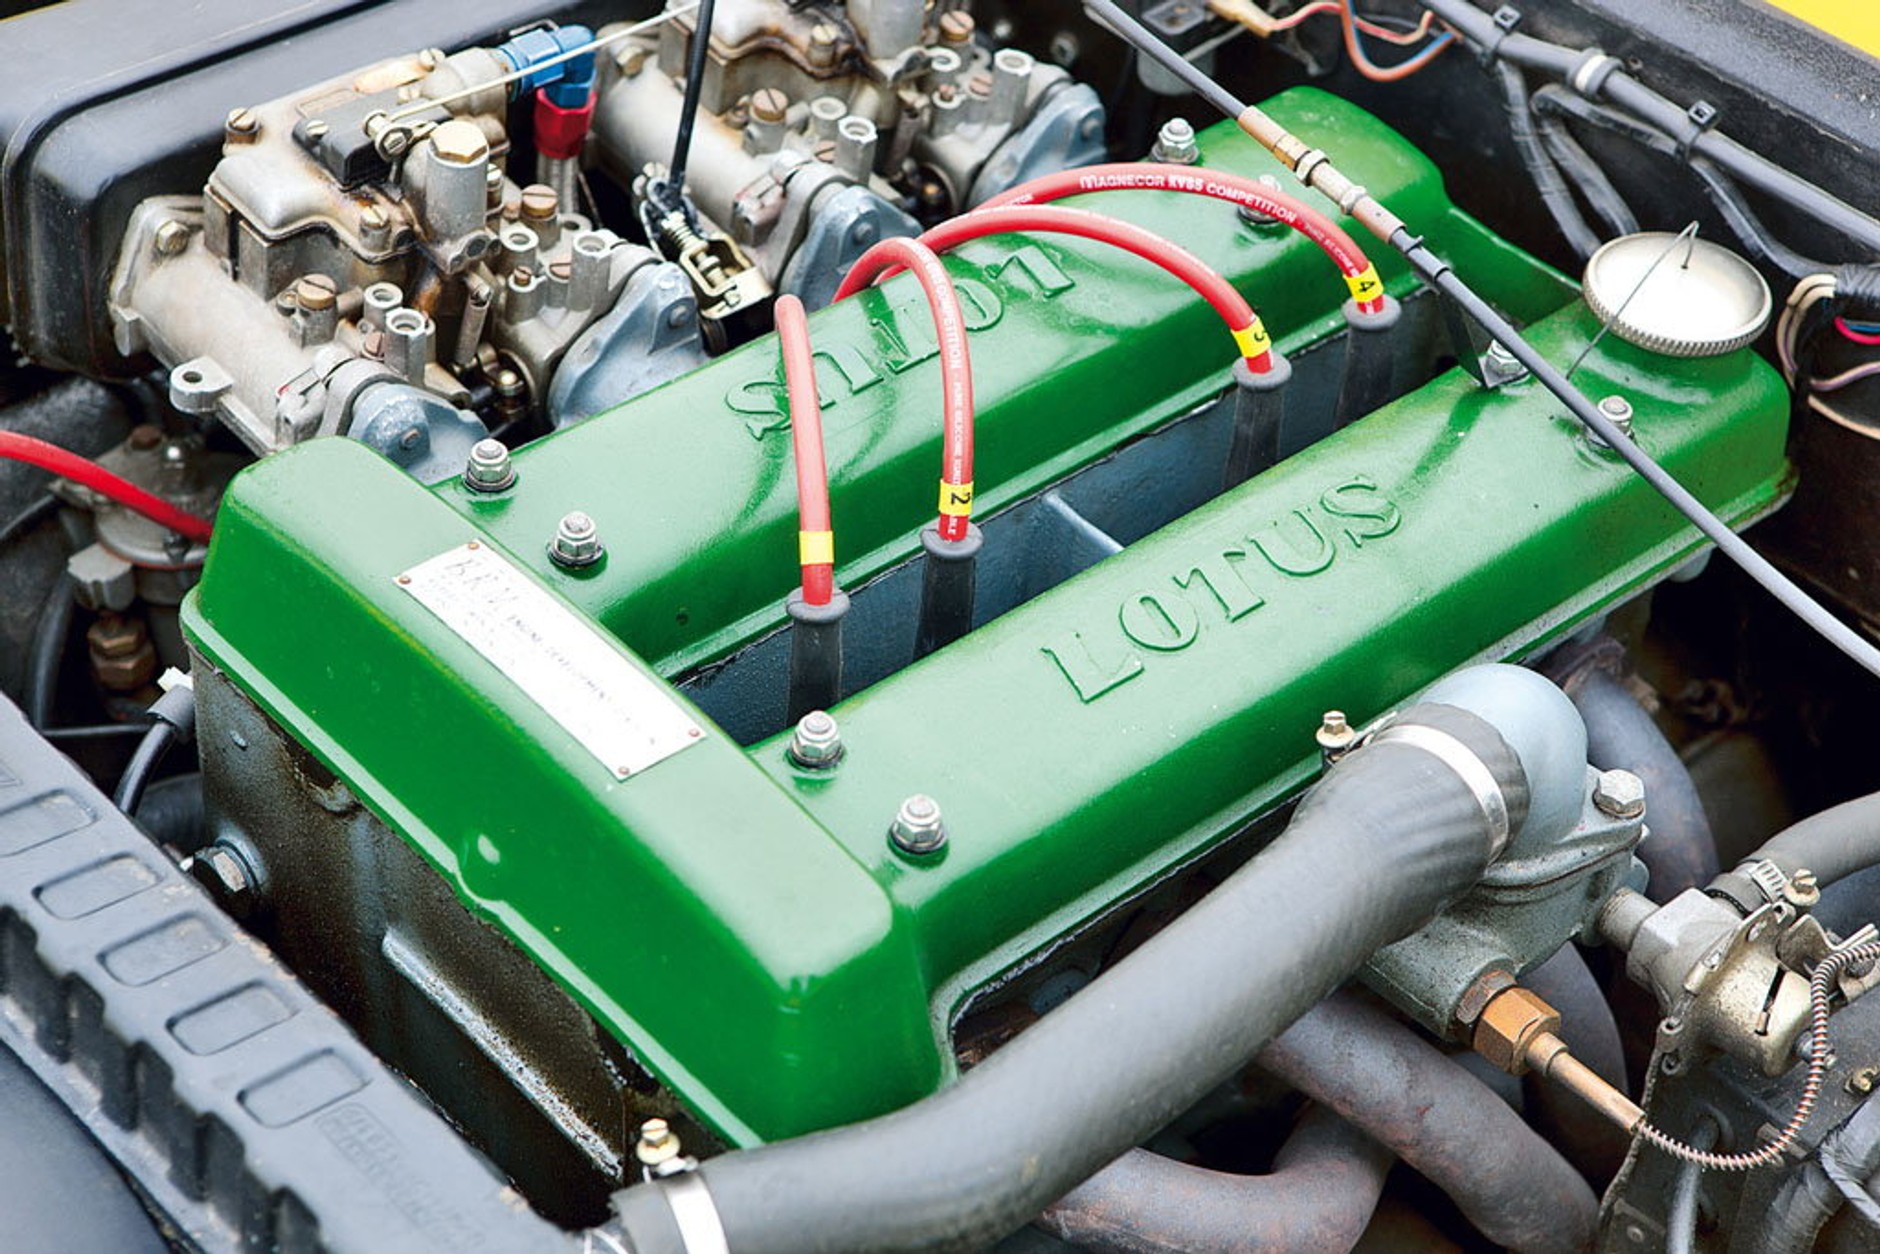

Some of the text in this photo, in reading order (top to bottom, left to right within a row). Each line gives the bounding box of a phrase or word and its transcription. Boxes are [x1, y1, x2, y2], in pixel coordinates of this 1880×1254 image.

[1080, 174, 1165, 189] MAGNECOR
[1206, 182, 1298, 224] COMPETITION
[1358, 281, 1376, 292] 4
[725, 245, 1076, 442] LOTUS
[950, 491, 971, 505] 2
[1040, 474, 1402, 705] LOTUS
